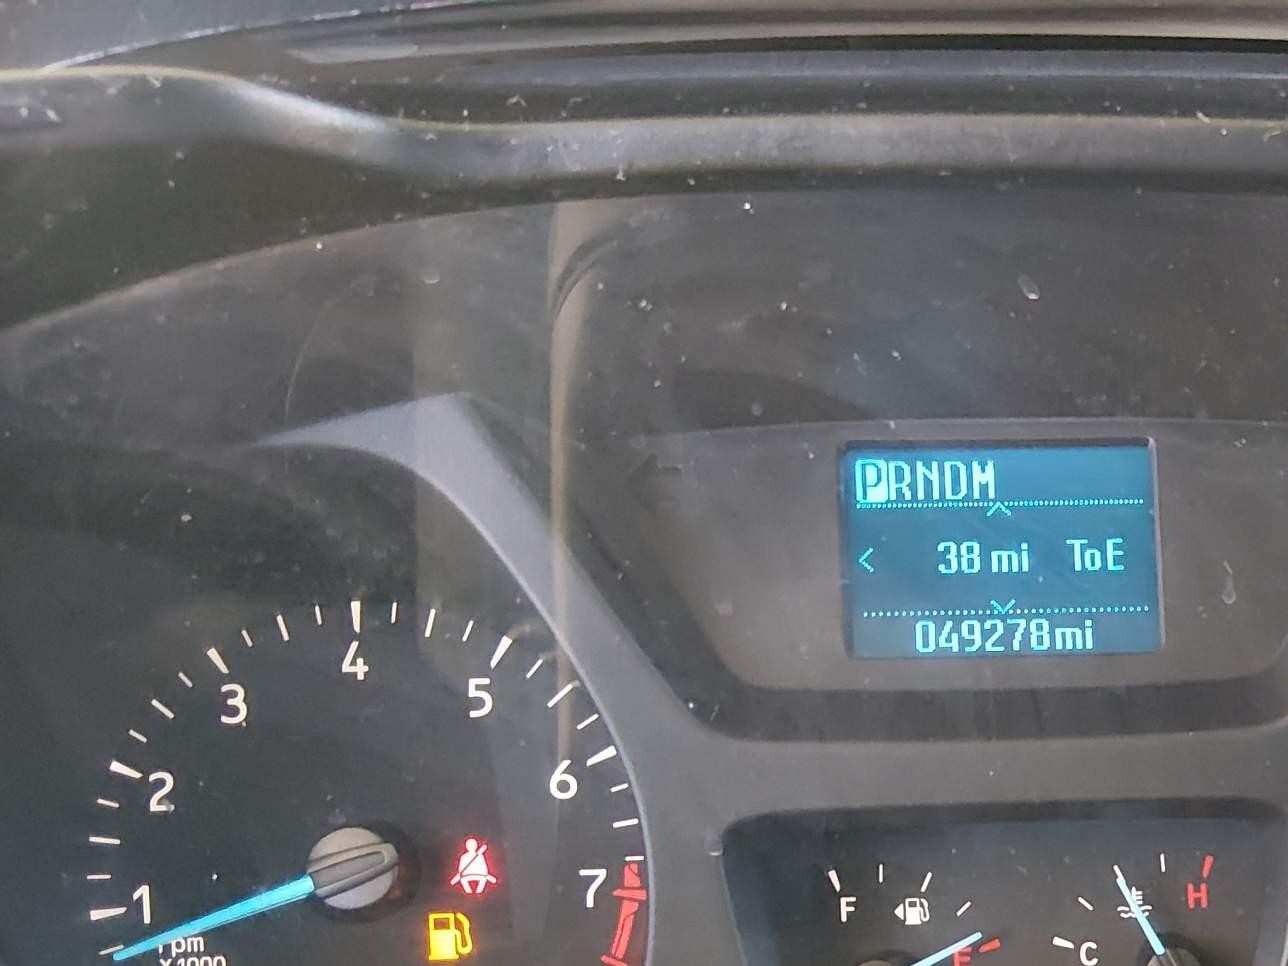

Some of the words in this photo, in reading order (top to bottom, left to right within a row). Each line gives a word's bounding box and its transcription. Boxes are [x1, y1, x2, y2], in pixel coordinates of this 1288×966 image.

[855, 459, 996, 502] PRNDM
[937, 541, 981, 574] 38
[991, 543, 1030, 573] mi
[1066, 538, 1125, 571] ToE
[342, 641, 368, 680] 4
[221, 684, 248, 725] 3
[469, 678, 492, 717] 5
[149, 772, 174, 812] 2
[549, 760, 577, 799] 6
[133, 885, 151, 924] 1
[579, 869, 606, 908] 7
[1187, 883, 1208, 909] H
[840, 897, 856, 922] F
[1080, 942, 1098, 966] C
